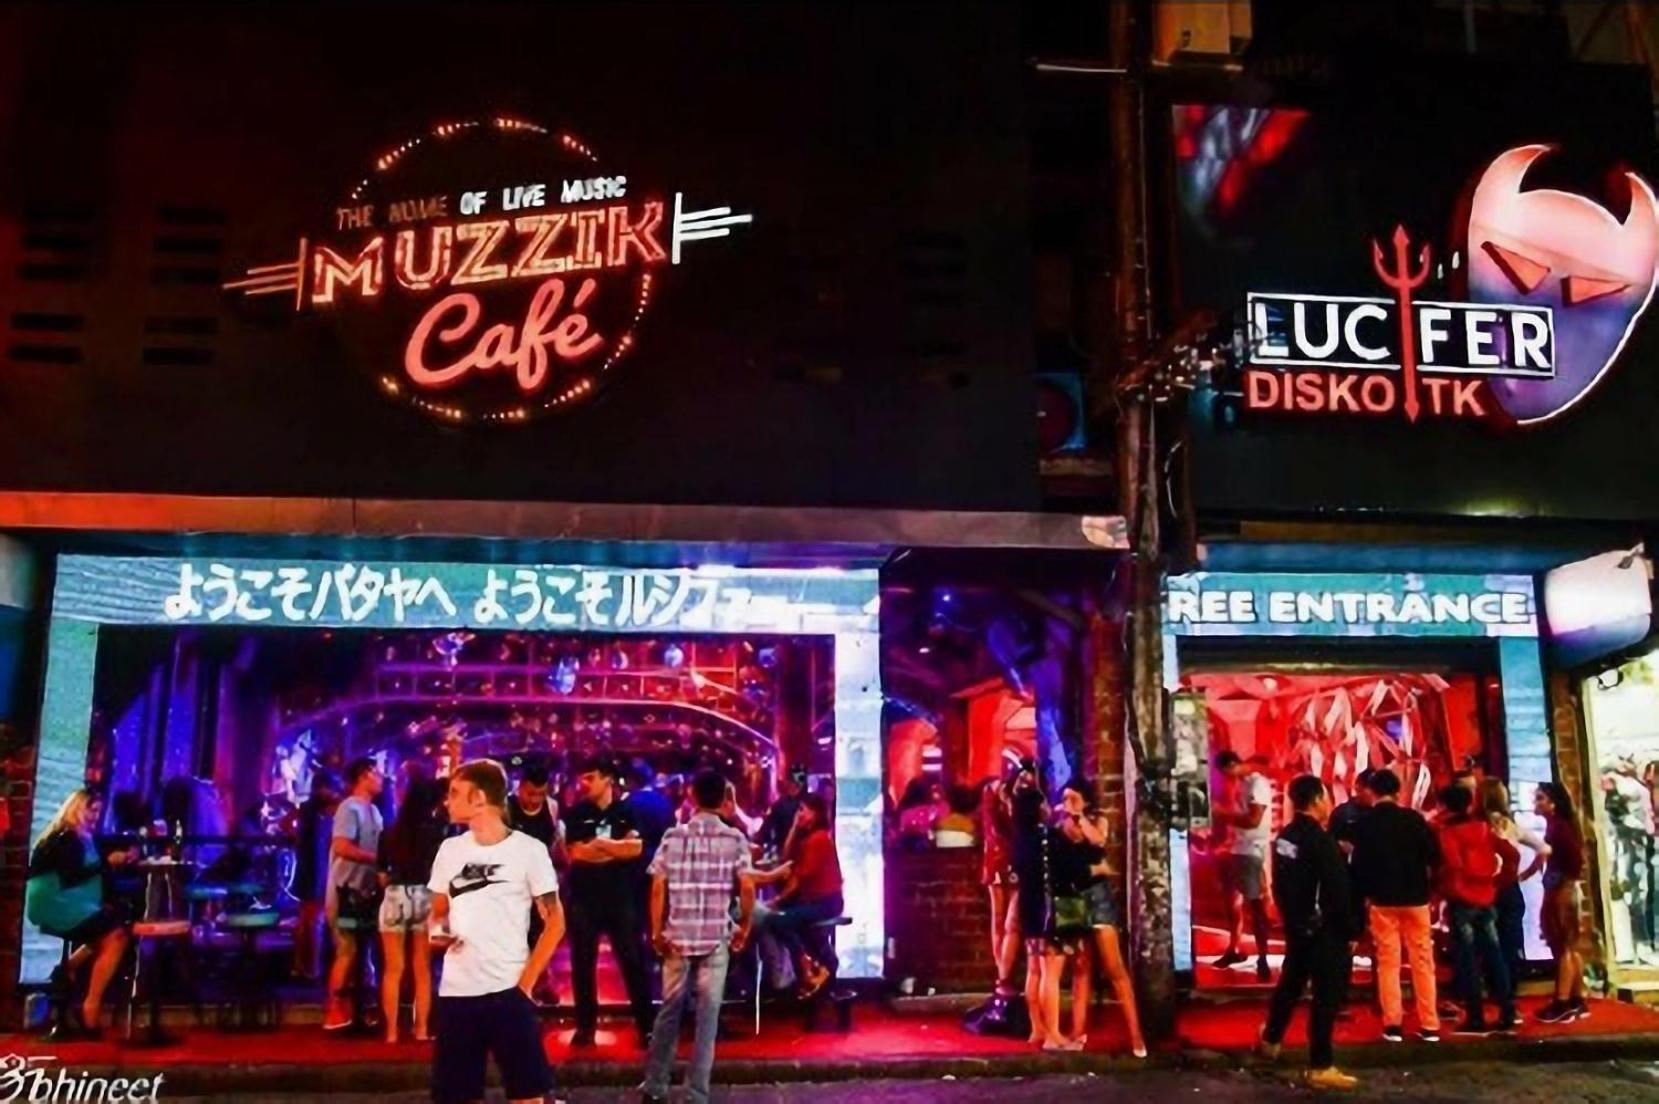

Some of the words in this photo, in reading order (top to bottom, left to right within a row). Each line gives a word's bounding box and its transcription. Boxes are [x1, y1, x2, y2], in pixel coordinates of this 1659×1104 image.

[335, 206, 375, 231] THE
[459, 184, 488, 215] OF
[502, 183, 547, 212] LIVE
[560, 175, 628, 205] MUSIC
[311, 200, 668, 303] MUZZIK
[404, 277, 602, 389] Café
[1160, 590, 1257, 624] REE
[1269, 590, 1531, 624] ENTRANCE
